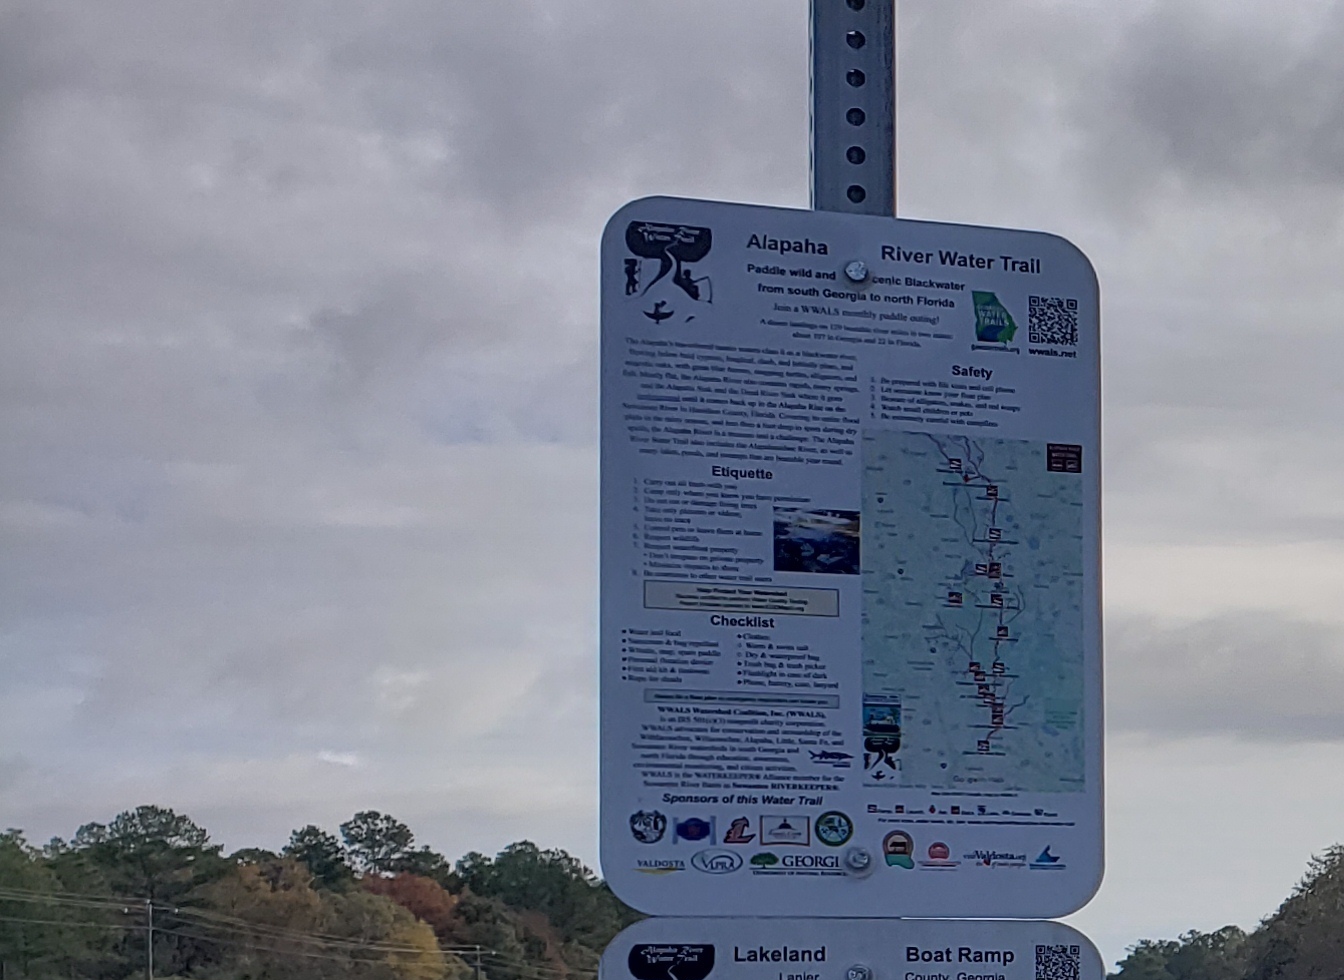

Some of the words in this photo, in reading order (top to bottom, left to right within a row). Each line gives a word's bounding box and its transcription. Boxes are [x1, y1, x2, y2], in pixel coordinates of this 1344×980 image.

[746, 234, 828, 257] Alapaha
[881, 245, 933, 264] River
[938, 250, 995, 270] Water
[1000, 255, 1040, 274] Trail
[747, 264, 786, 277] Paddle
[790, 267, 812, 278] wild
[815, 269, 836, 280] and
[871, 274, 900, 286] cenic
[905, 276, 965, 291] Blackwater
[758, 283, 784, 294] from
[787, 285, 819, 297] south
[822, 288, 866, 302] Georgia
[870, 292, 881, 301] to
[885, 293, 913, 304] north
[917, 296, 955, 308] Florida
[801, 305, 840, 316] WWALS
[879, 311, 907, 323] paddle
[1029, 347, 1077, 358] wwals.net
[952, 365, 993, 381] Safety
[711, 465, 773, 480] Etiquette
[710, 614, 775, 629] Checklist
[662, 793, 718, 804] Sponsors
[722, 795, 734, 804] of
[737, 795, 758, 804] this
[762, 796, 795, 805] Water
[798, 796, 823, 806] Trail
[637, 860, 685, 868] VALDOSTA
[782, 855, 840, 868] GEORGI
[735, 946, 826, 963] Lakeland
[906, 947, 952, 963] Boat
[958, 947, 1015, 967] Ramp
